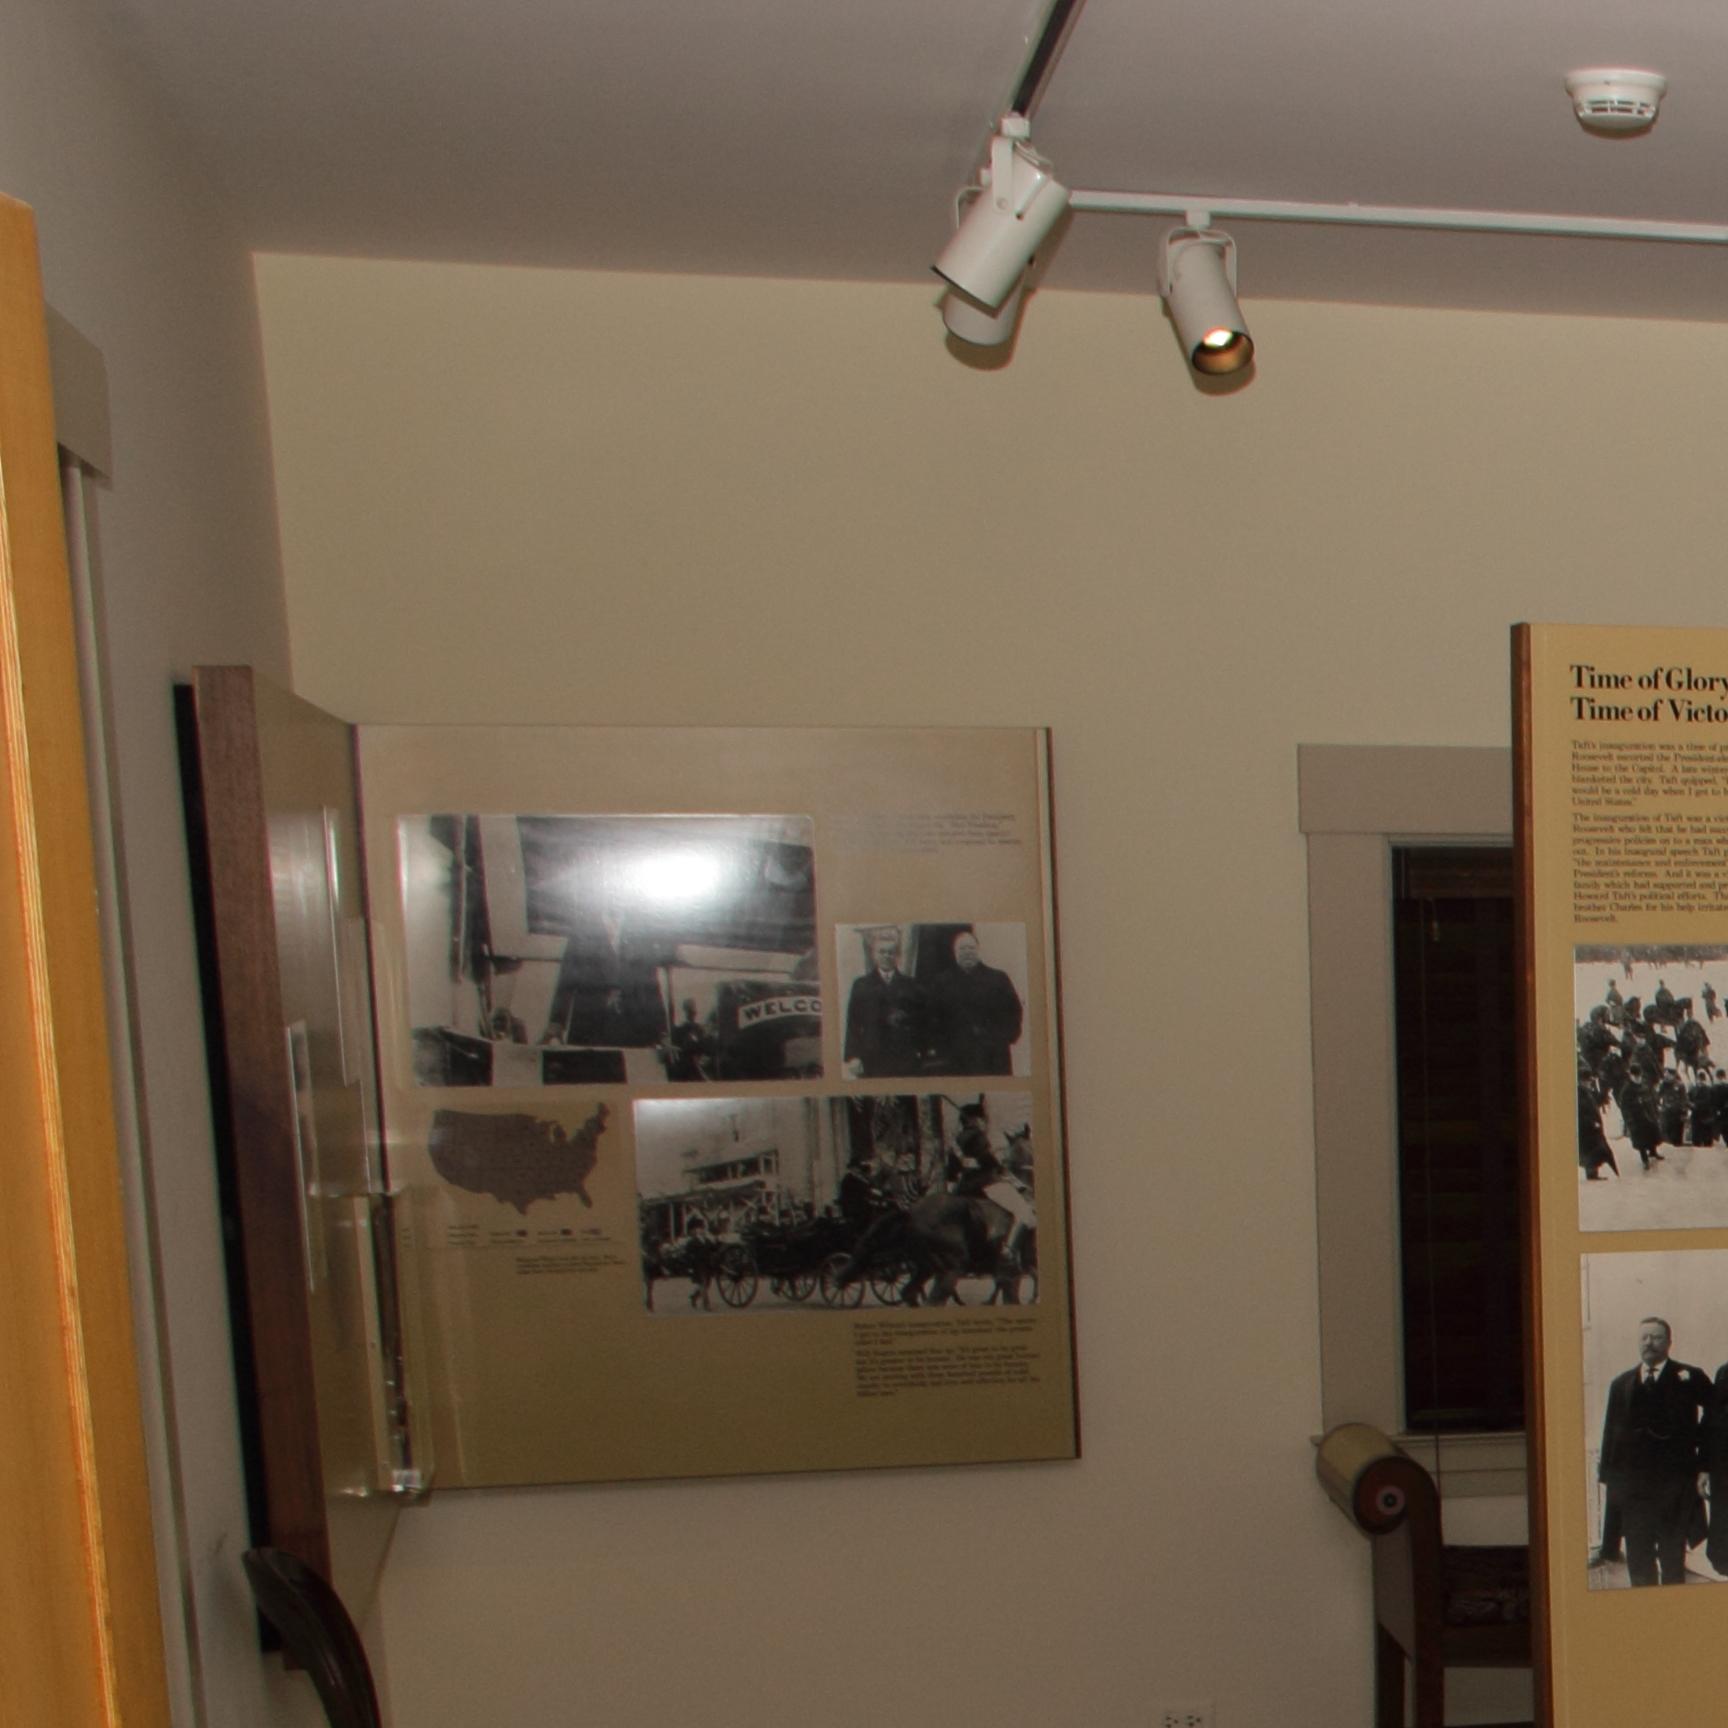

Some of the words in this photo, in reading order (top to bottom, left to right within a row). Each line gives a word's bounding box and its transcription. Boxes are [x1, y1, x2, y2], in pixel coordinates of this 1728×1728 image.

[1570, 664, 1632, 690] Time
[1638, 667, 1664, 690] of
[1570, 696, 1633, 721] Time
[1637, 698, 1664, 721] of
